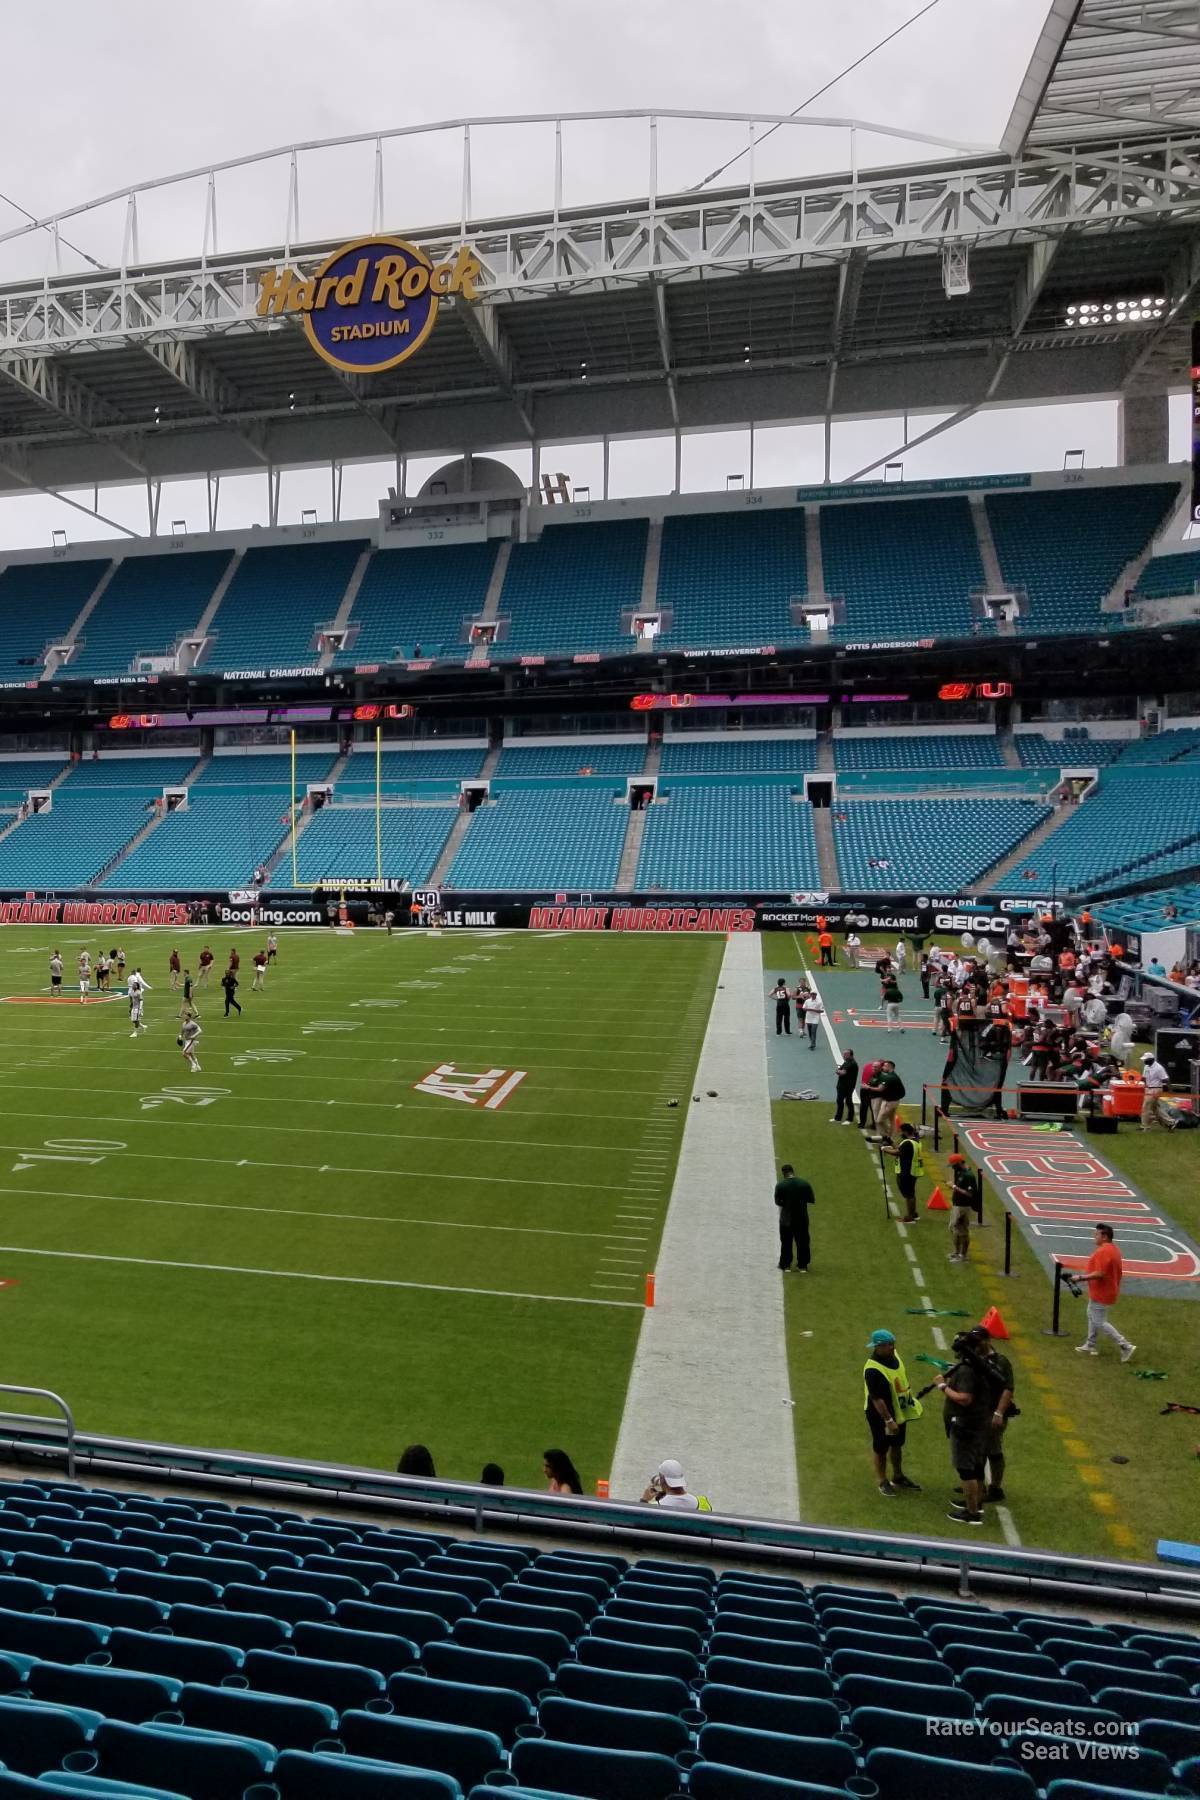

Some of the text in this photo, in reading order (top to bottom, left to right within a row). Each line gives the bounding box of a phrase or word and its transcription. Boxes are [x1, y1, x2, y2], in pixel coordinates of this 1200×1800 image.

[256, 246, 482, 316] Hard Rock
[330, 319, 410, 344] STADIUM
[745, 496, 763, 505] 334
[302, 530, 316, 539] 331
[427, 531, 445, 540] 332
[871, 641, 919, 649] ANDERSON
[683, 650, 709, 658] VINNY
[710, 647, 761, 657] TESTAVERDE
[223, 667, 324, 680] NATIONAL CHAMPIONS
[321, 878, 399, 892] MUSCLE MILK
[416, 893, 436, 907] 40
[62, 902, 189, 925] HURRICANES
[464, 911, 496, 926] MILK
[528, 907, 756, 931] MIAMI HURRICANES
[762, 913, 840, 924] ROCKET Mortage
[871, 915, 918, 928] BACARDÍ
[935, 914, 1010, 932] GEICO
[414, 1063, 507, 1104] ACC
[139, 1086, 232, 1106] 20
[17, 1138, 128, 1165] 10
